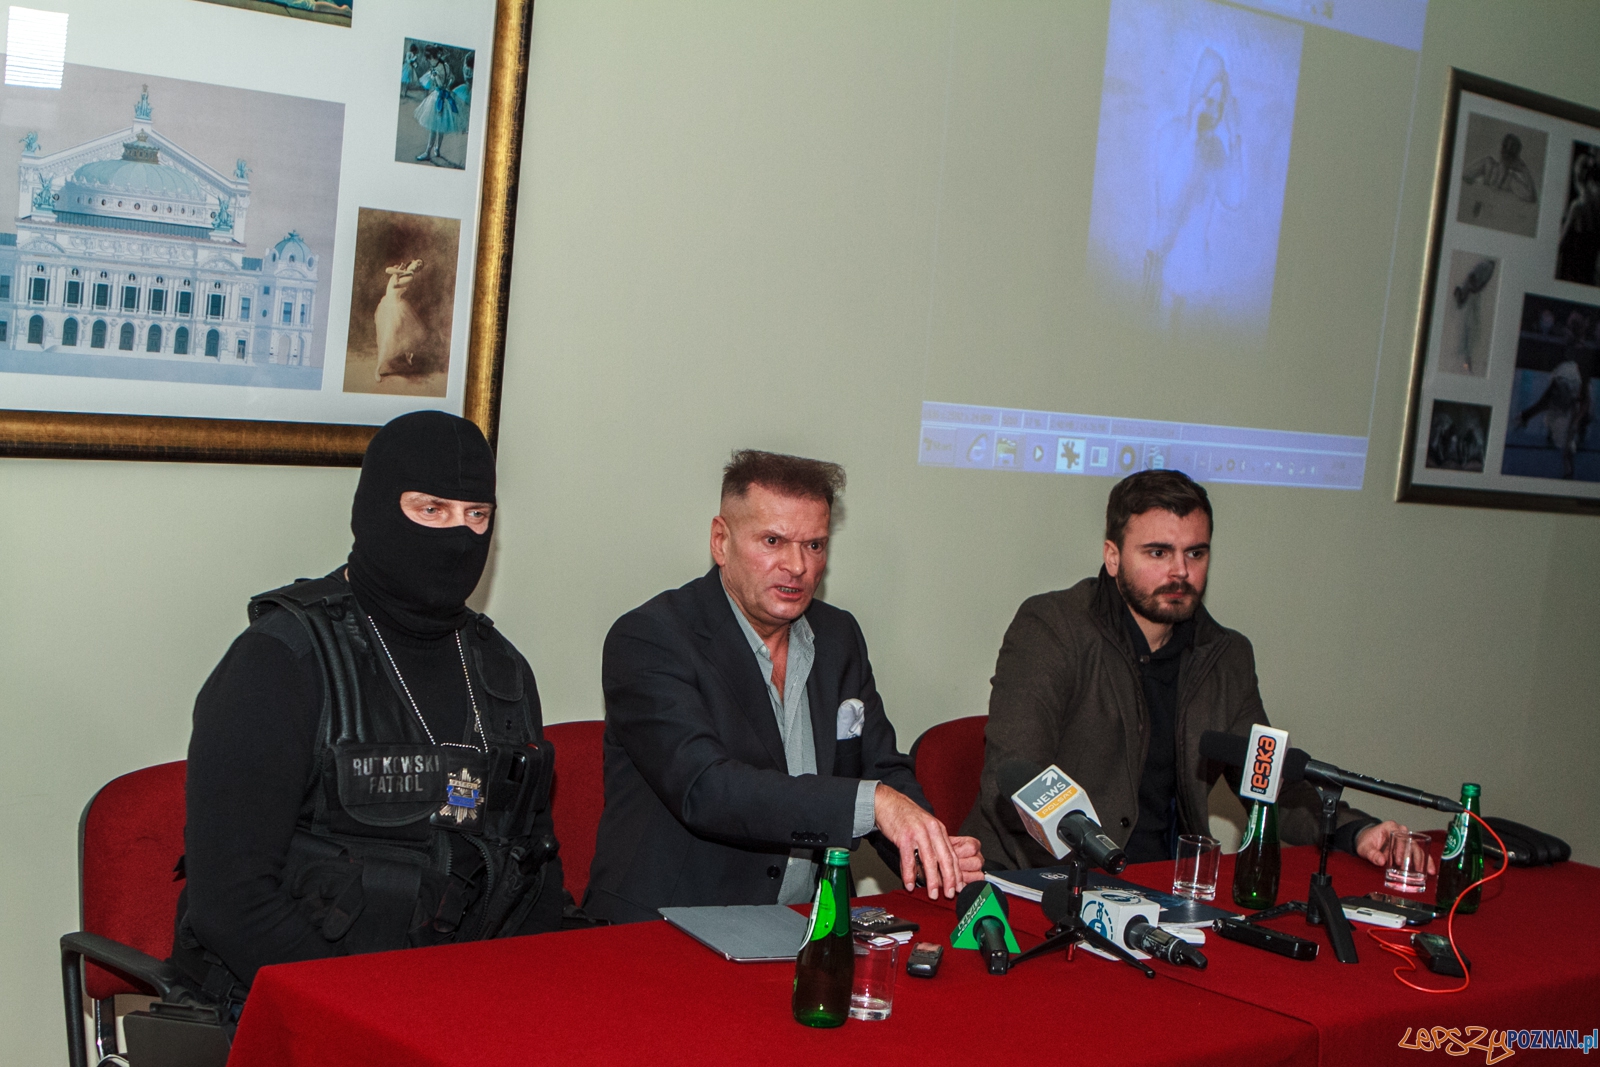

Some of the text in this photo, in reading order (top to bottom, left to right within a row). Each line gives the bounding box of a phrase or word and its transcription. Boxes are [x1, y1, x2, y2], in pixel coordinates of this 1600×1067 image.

[369, 775, 424, 794] PATROL
[1032, 781, 1067, 809] NEWS
[1041, 789, 1073, 815] POLSAT
